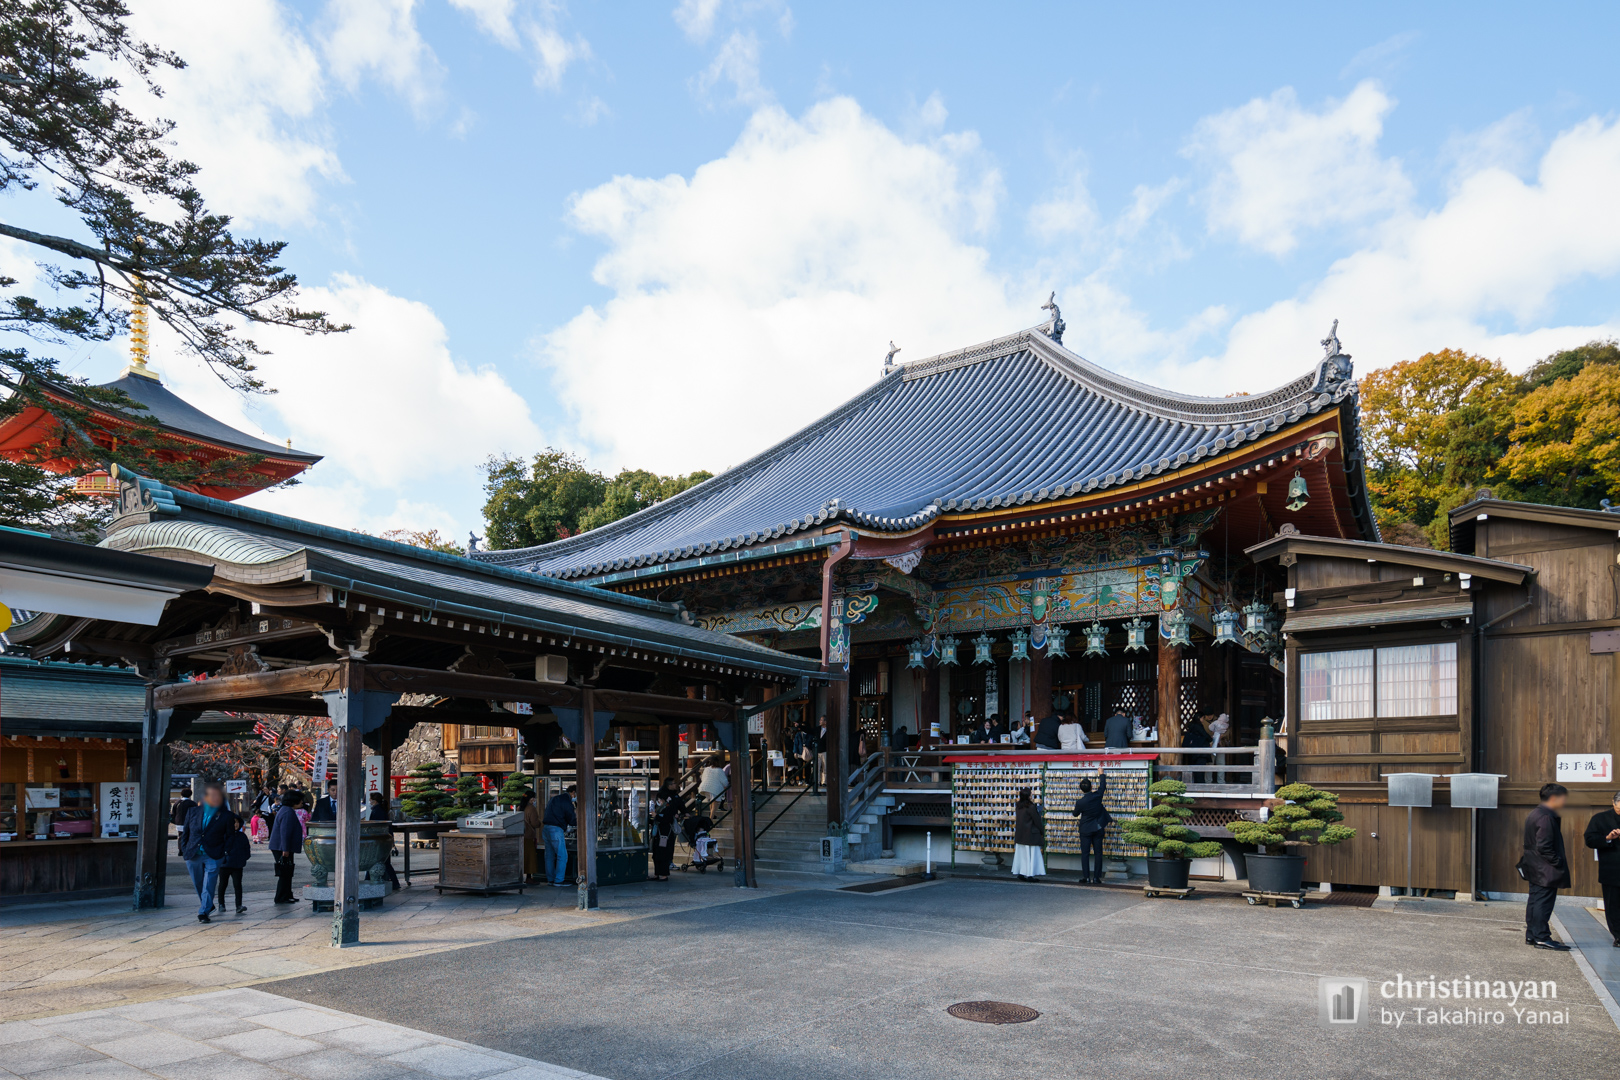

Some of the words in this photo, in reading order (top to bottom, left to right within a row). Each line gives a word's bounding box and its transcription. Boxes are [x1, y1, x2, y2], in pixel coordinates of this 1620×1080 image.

[1557, 761, 1597, 771] お手洗
[109, 786, 122, 821] 受付所
